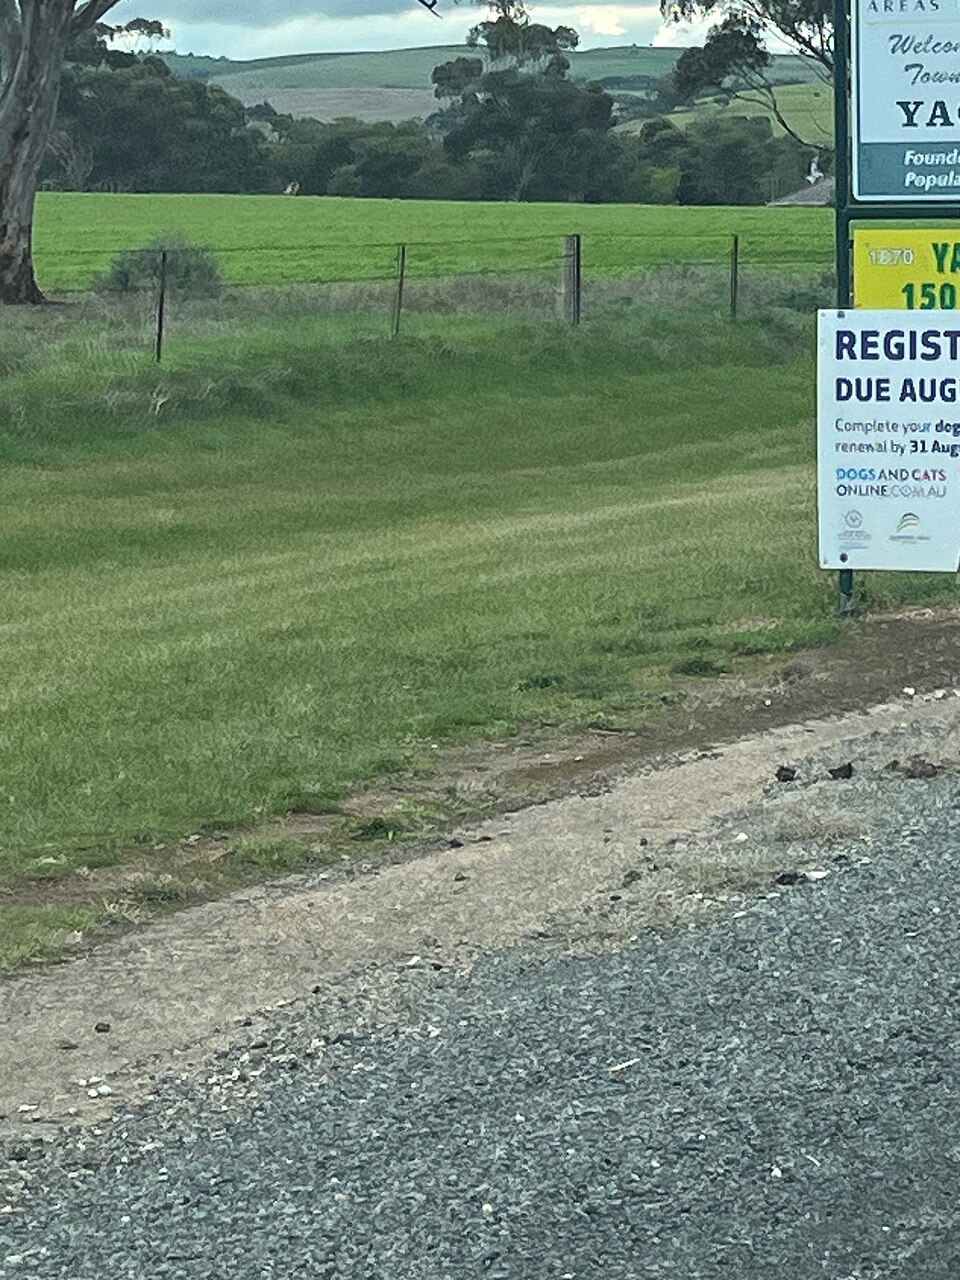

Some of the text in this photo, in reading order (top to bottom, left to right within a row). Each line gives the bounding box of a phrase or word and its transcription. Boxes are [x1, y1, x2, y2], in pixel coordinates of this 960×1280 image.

[869, 248, 913, 265] 1870
[901, 283, 956, 310] 150
[835, 378, 891, 403] DUE
[835, 418, 899, 436] Complete
[902, 421, 931, 436] your
[935, 420, 960, 436] dog
[835, 441, 888, 454] renewal
[890, 441, 906, 456] by
[910, 441, 928, 453] 31
